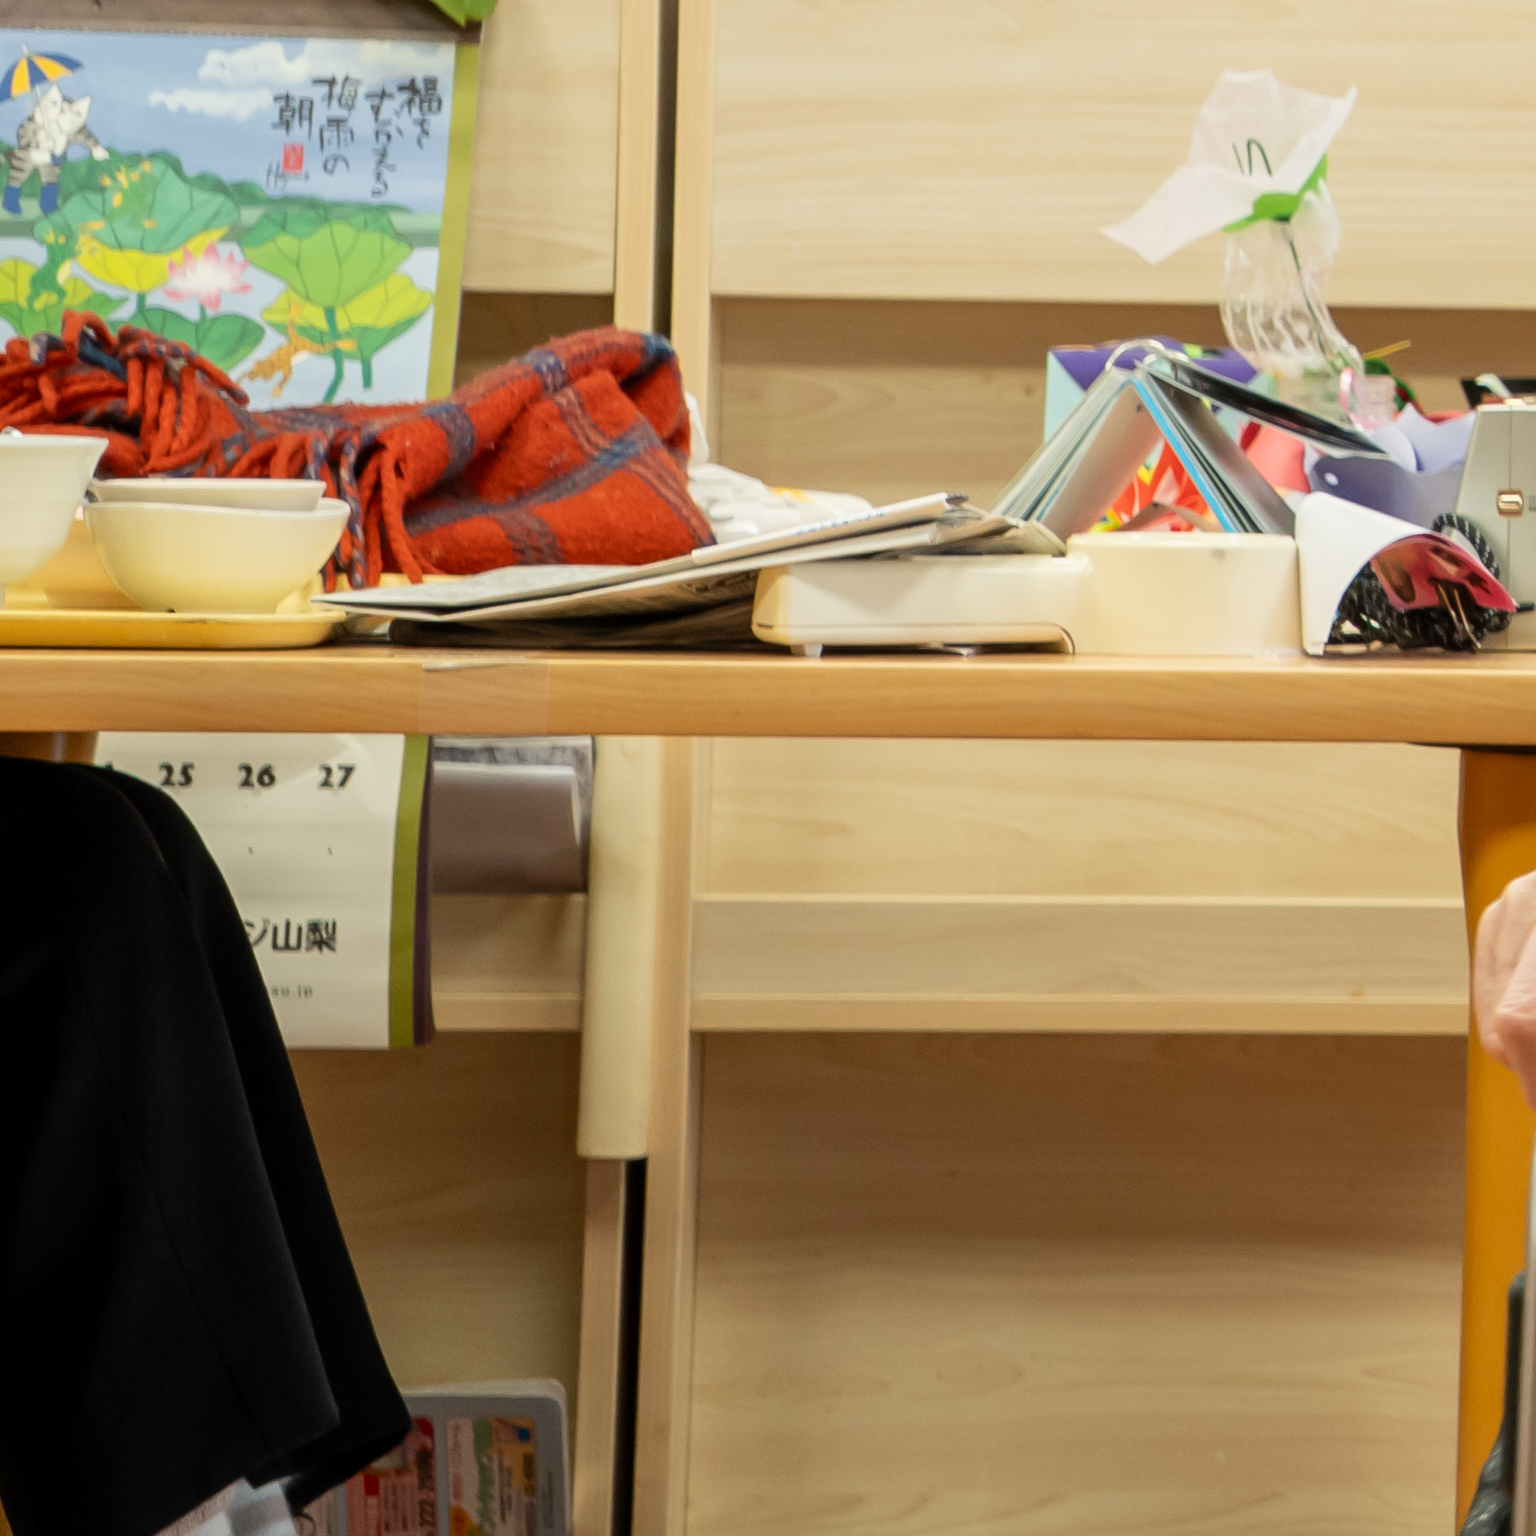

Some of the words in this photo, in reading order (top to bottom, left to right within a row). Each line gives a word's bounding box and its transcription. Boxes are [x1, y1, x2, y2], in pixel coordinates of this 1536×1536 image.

[270, 89, 315, 141] 朝
[159, 762, 194, 787] 25
[237, 762, 276, 787] 26
[317, 763, 356, 789] 27
